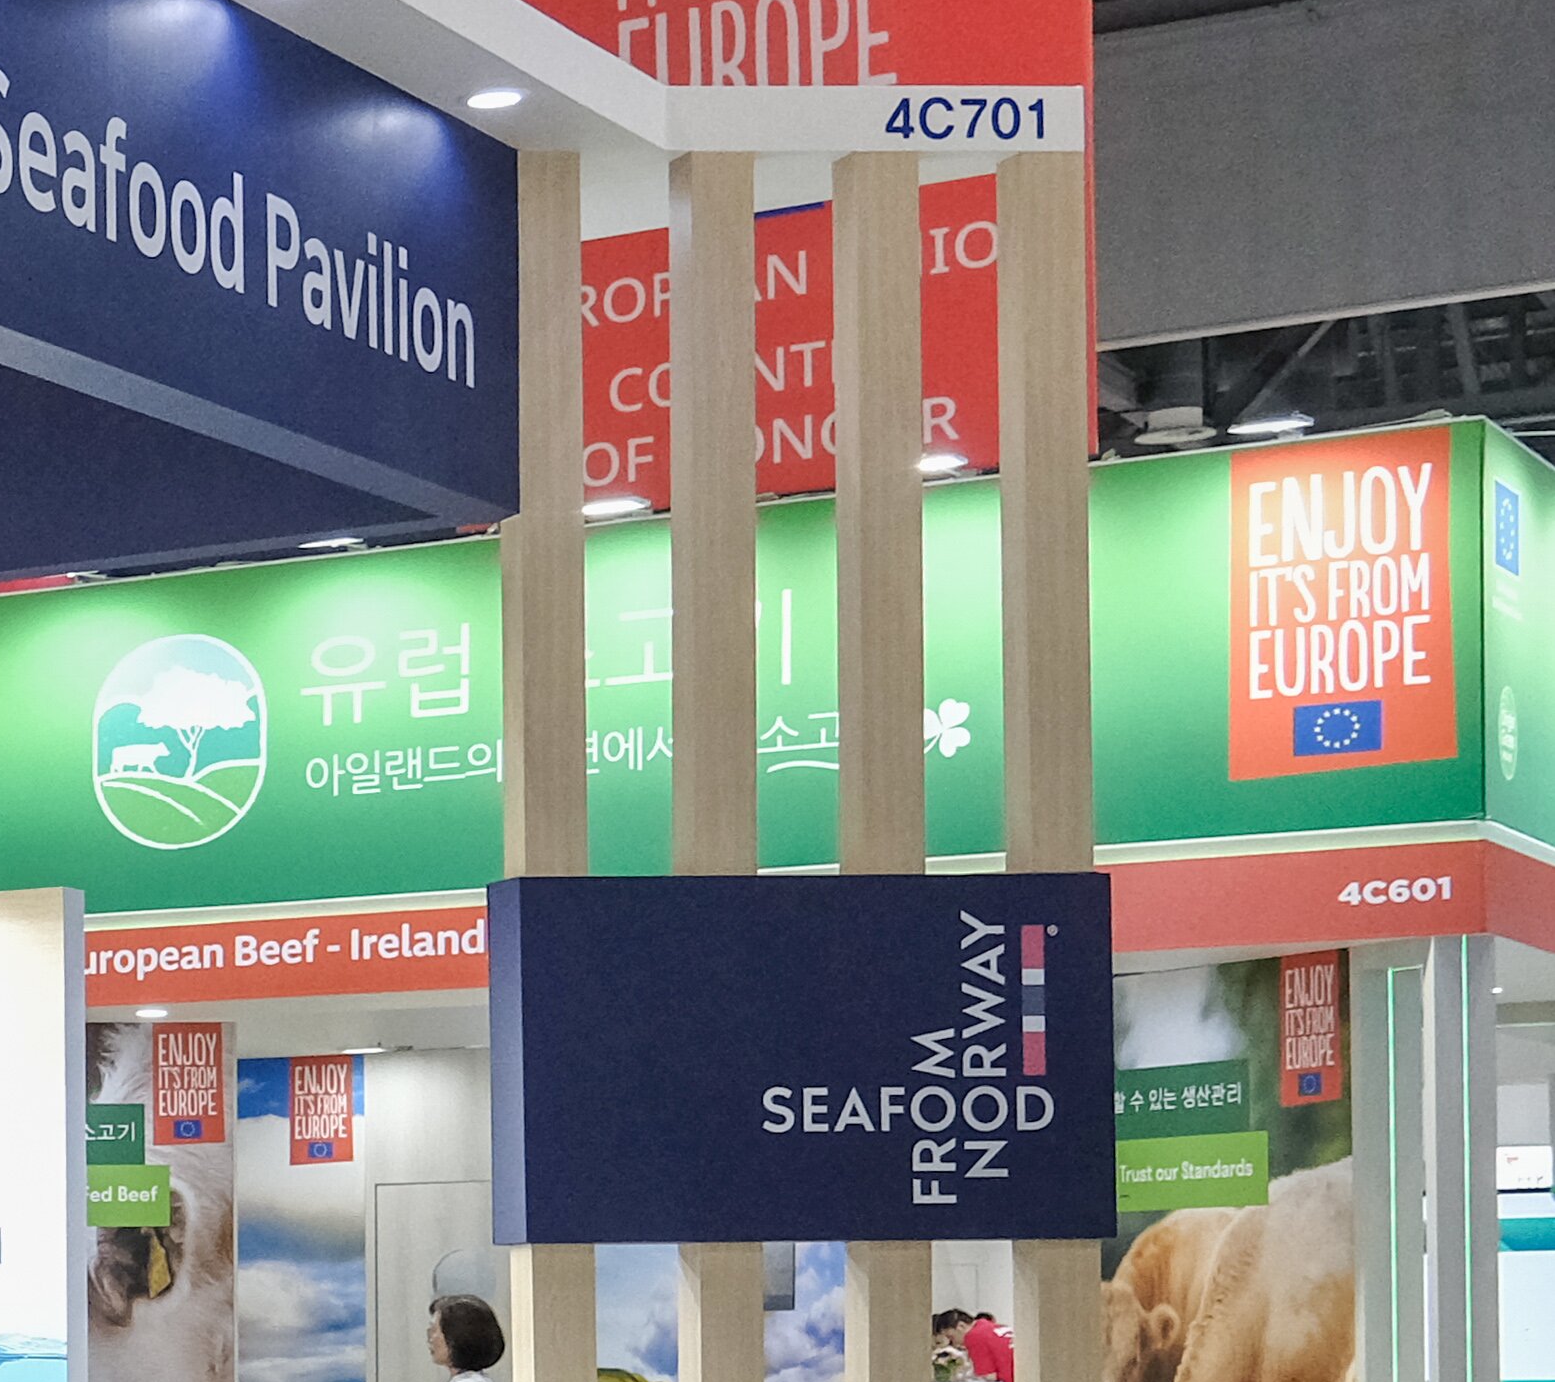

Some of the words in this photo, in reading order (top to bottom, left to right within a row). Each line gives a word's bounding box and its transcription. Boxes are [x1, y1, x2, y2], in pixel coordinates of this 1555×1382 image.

[884, 97, 1046, 140] 4C701
[267, 192, 475, 388] Pavilion
[583, 435, 654, 487] OF
[1249, 462, 1432, 568] ENJOY
[1249, 563, 1317, 627] IT'S
[1328, 552, 1430, 621] FROM
[300, 622, 471, 727] 유럽
[1249, 615, 1431, 700] EUROPE
[305, 737, 504, 797] 아일랜드의
[1337, 876, 1452, 907] 4C601
[83, 942, 225, 979] uropean
[234, 931, 318, 968] Beef
[350, 920, 485, 961] Ireland
[1286, 964, 1335, 1009] ENJOY
[1286, 1009, 1304, 1036] IT'S
[1306, 1006, 1335, 1033] FROM
[158, 1032, 217, 1066] ENJOY
[960, 910, 1009, 1178] NORWAY
[1285, 1034, 1335, 1070] EUROPE
[158, 1067, 180, 1090] IT'S
[184, 1066, 217, 1089] FROM
[294, 1064, 347, 1095] ENJOY
[1129, 1090, 1144, 1112] 수
[1148, 1087, 1177, 1110] 있는
[1181, 1082, 1242, 1109] 생산관리
[158, 1089, 218, 1116] EUROPE
[294, 1094, 316, 1115] IT'S
[317, 1093, 347, 1113] FROM
[762, 1085, 1055, 1133] SEAFOOD
[910, 1028, 957, 1205] FROM
[294, 1113, 348, 1140] EUROPE
[1119, 1164, 1153, 1183] Trust
[1155, 1166, 1179, 1181] our
[1181, 1159, 1254, 1180] Standards
[117, 1185, 158, 1202] Beef
